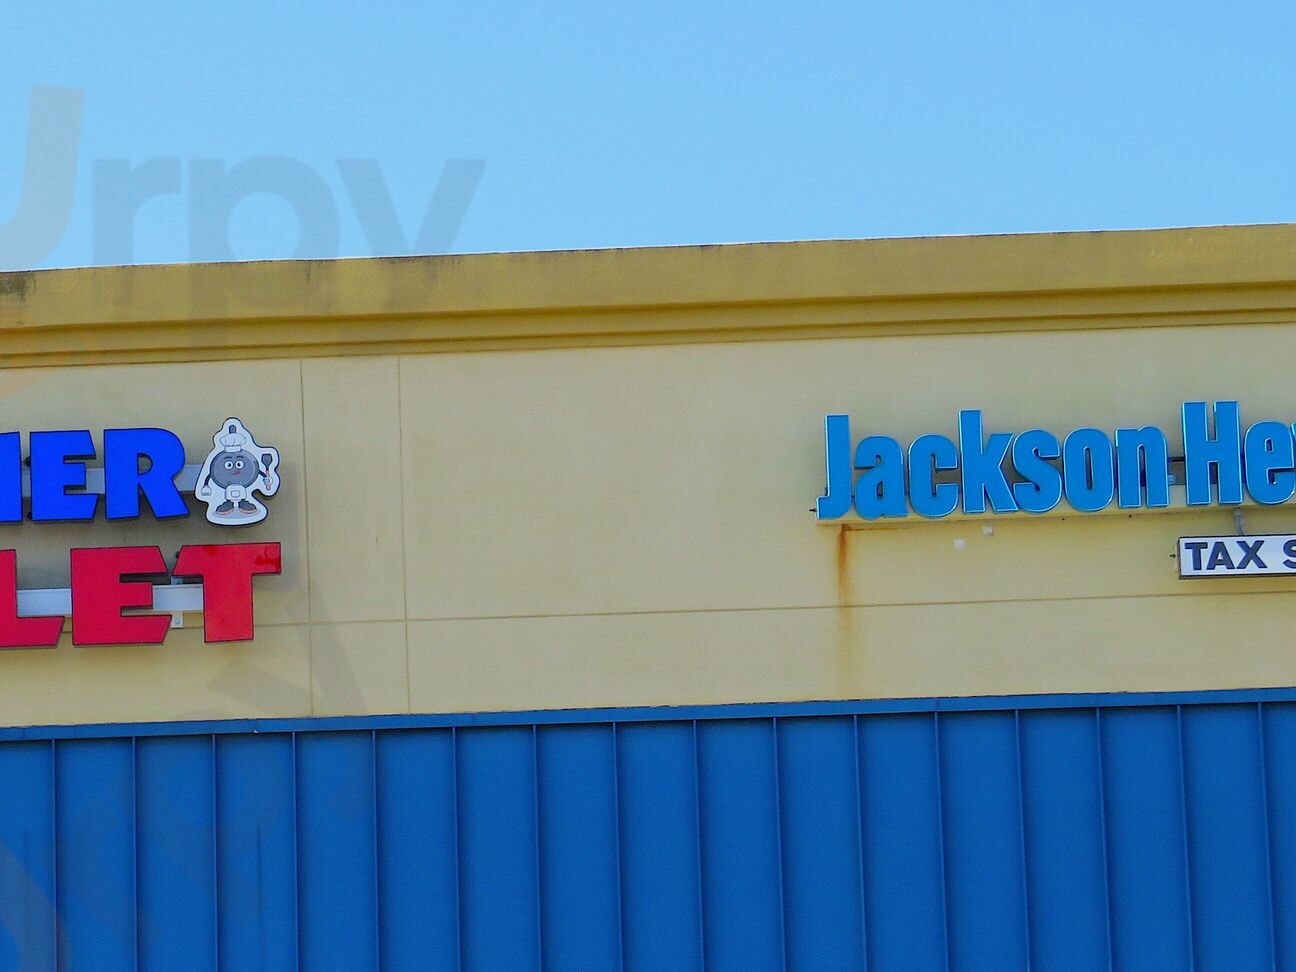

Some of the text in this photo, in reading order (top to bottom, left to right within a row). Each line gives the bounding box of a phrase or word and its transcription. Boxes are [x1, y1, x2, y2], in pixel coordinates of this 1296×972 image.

[816, 401, 1296, 520] Jackson He
[1184, 540, 1268, 571] TAX
